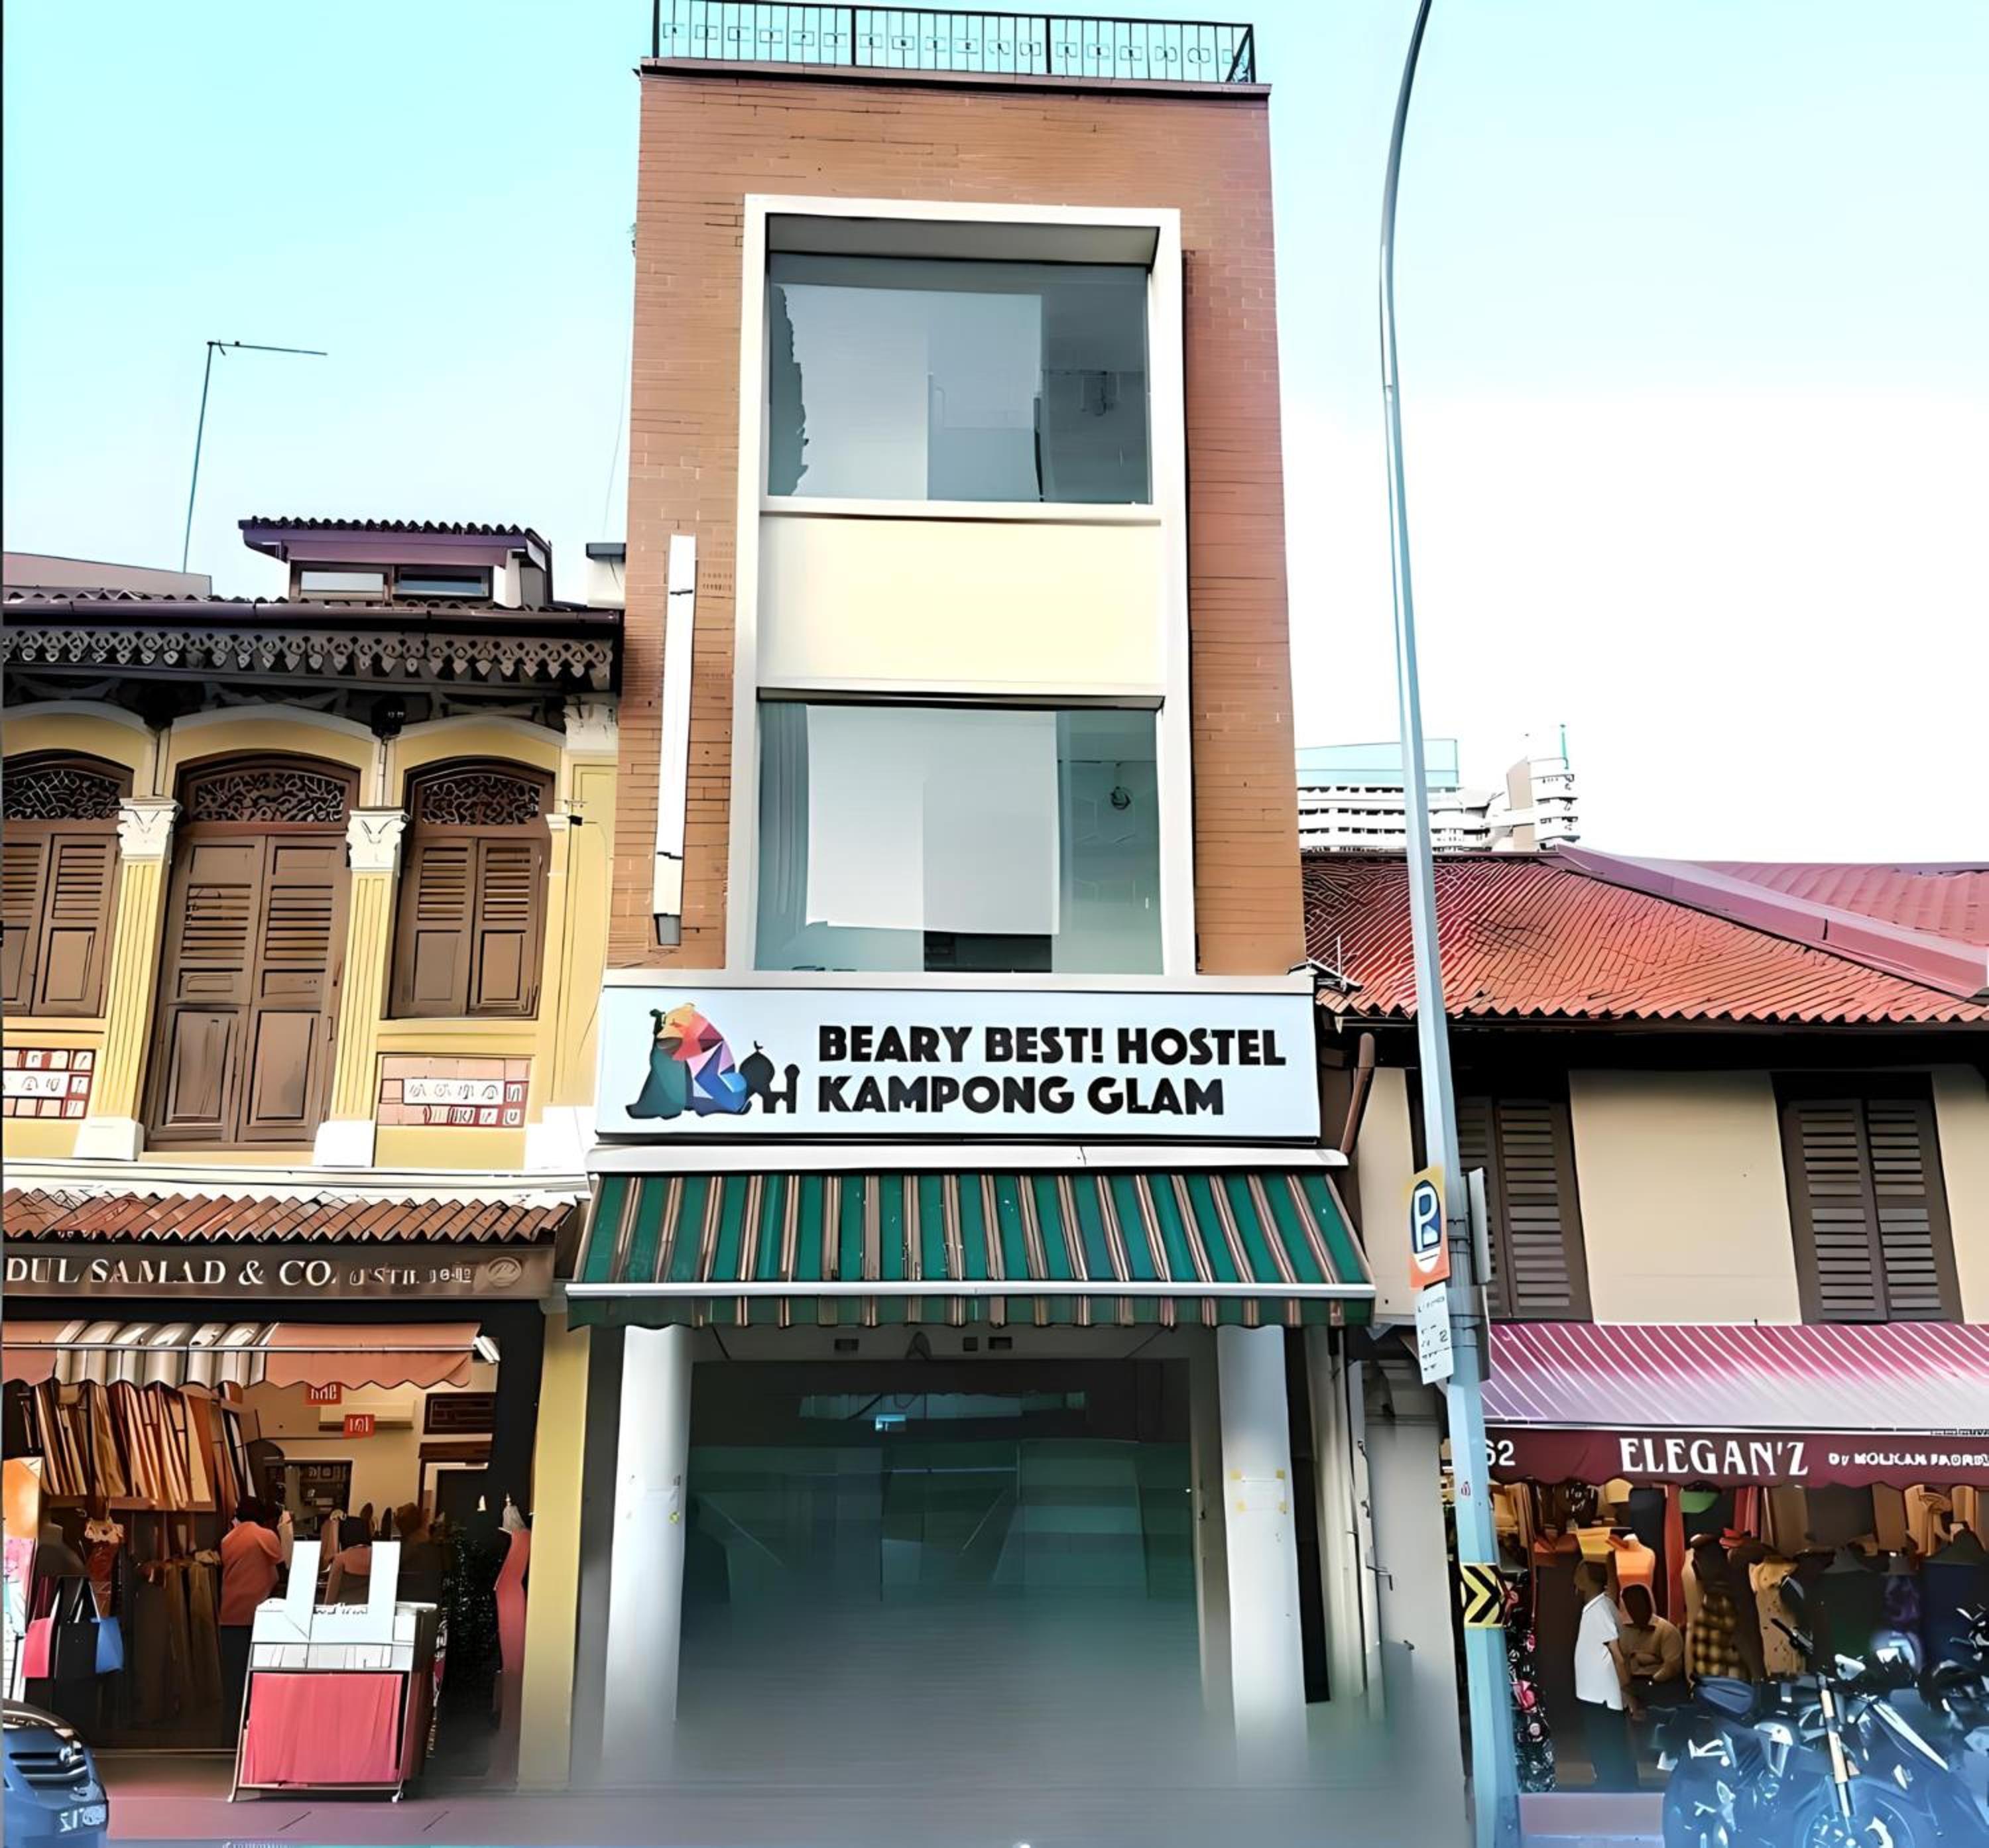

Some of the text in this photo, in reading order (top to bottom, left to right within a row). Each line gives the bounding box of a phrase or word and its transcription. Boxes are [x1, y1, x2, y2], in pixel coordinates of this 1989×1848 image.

[819, 1025, 1286, 1066] BEARY BEST! HOSTEL
[818, 1076, 1225, 1116] KAMPONG GLAM
[238, 1260, 264, 1285] &
[1619, 1437, 1809, 1476] ELEGAN'Z
